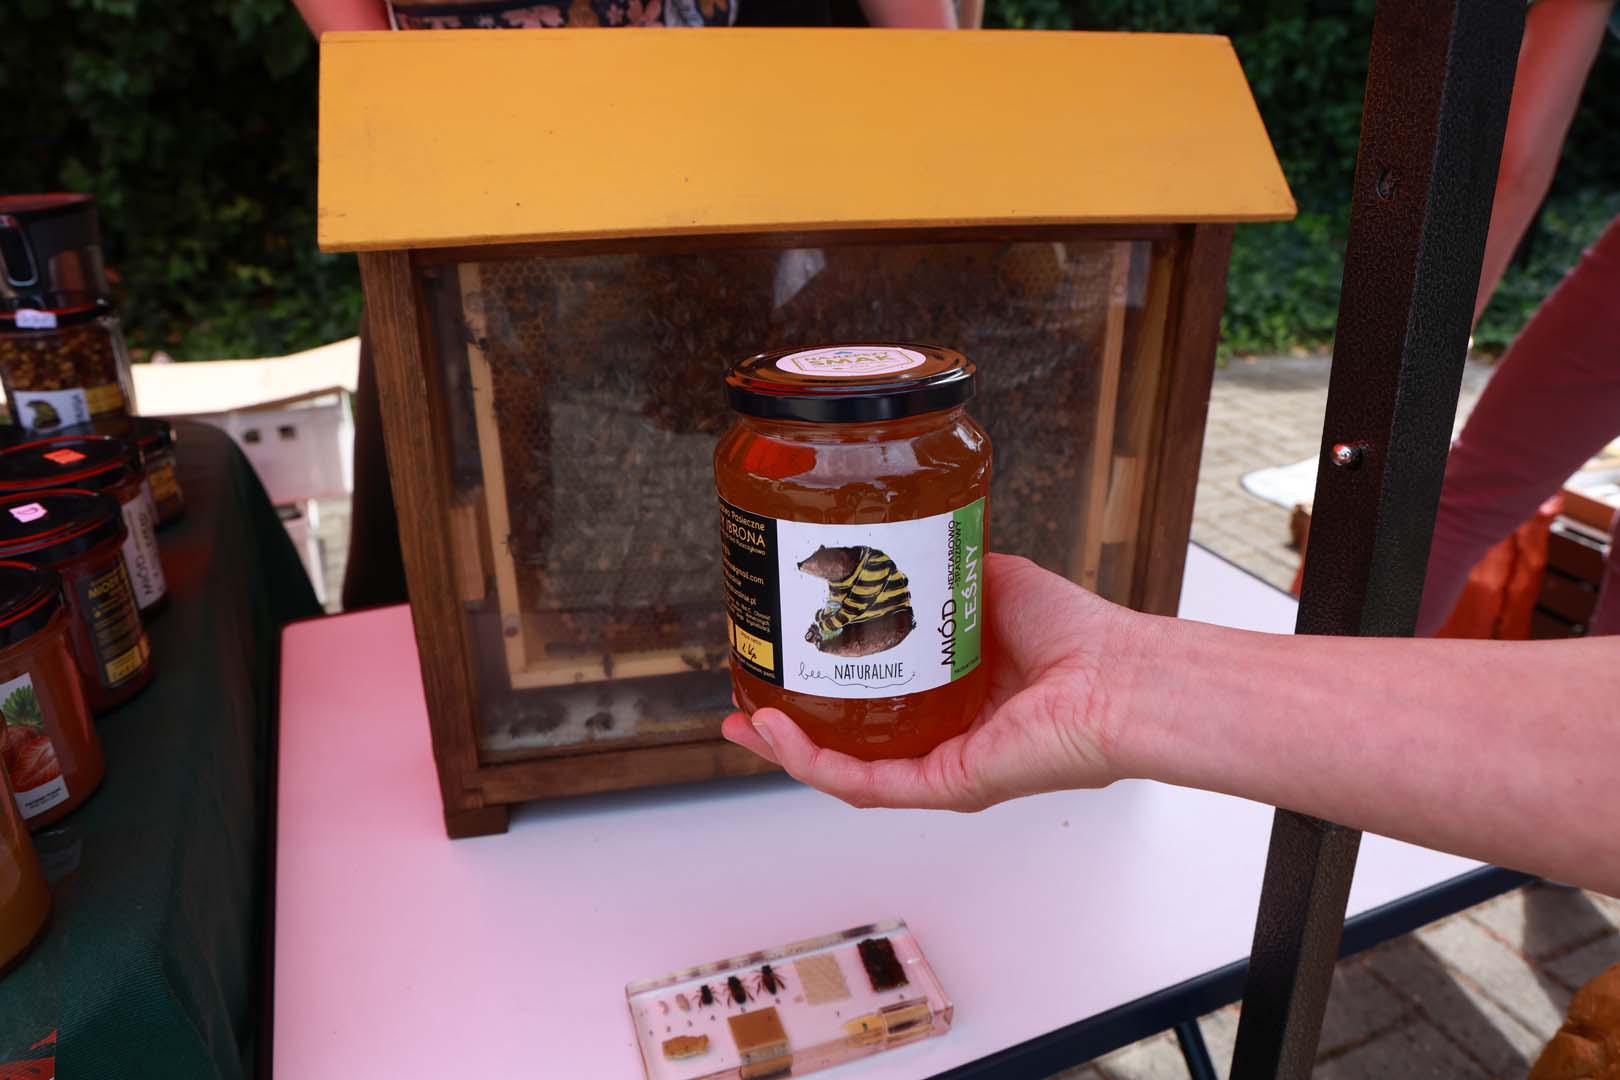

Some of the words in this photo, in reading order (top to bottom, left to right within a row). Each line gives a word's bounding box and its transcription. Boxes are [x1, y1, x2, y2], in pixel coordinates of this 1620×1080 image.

[731, 511, 765, 531] Pasieczne
[948, 520, 956, 590] NEKTAROWO
[961, 544, 978, 633] LEŚNY
[937, 599, 957, 666] MIÓD
[797, 661, 825, 680] bee
[834, 662, 904, 680] NATURALNIE
